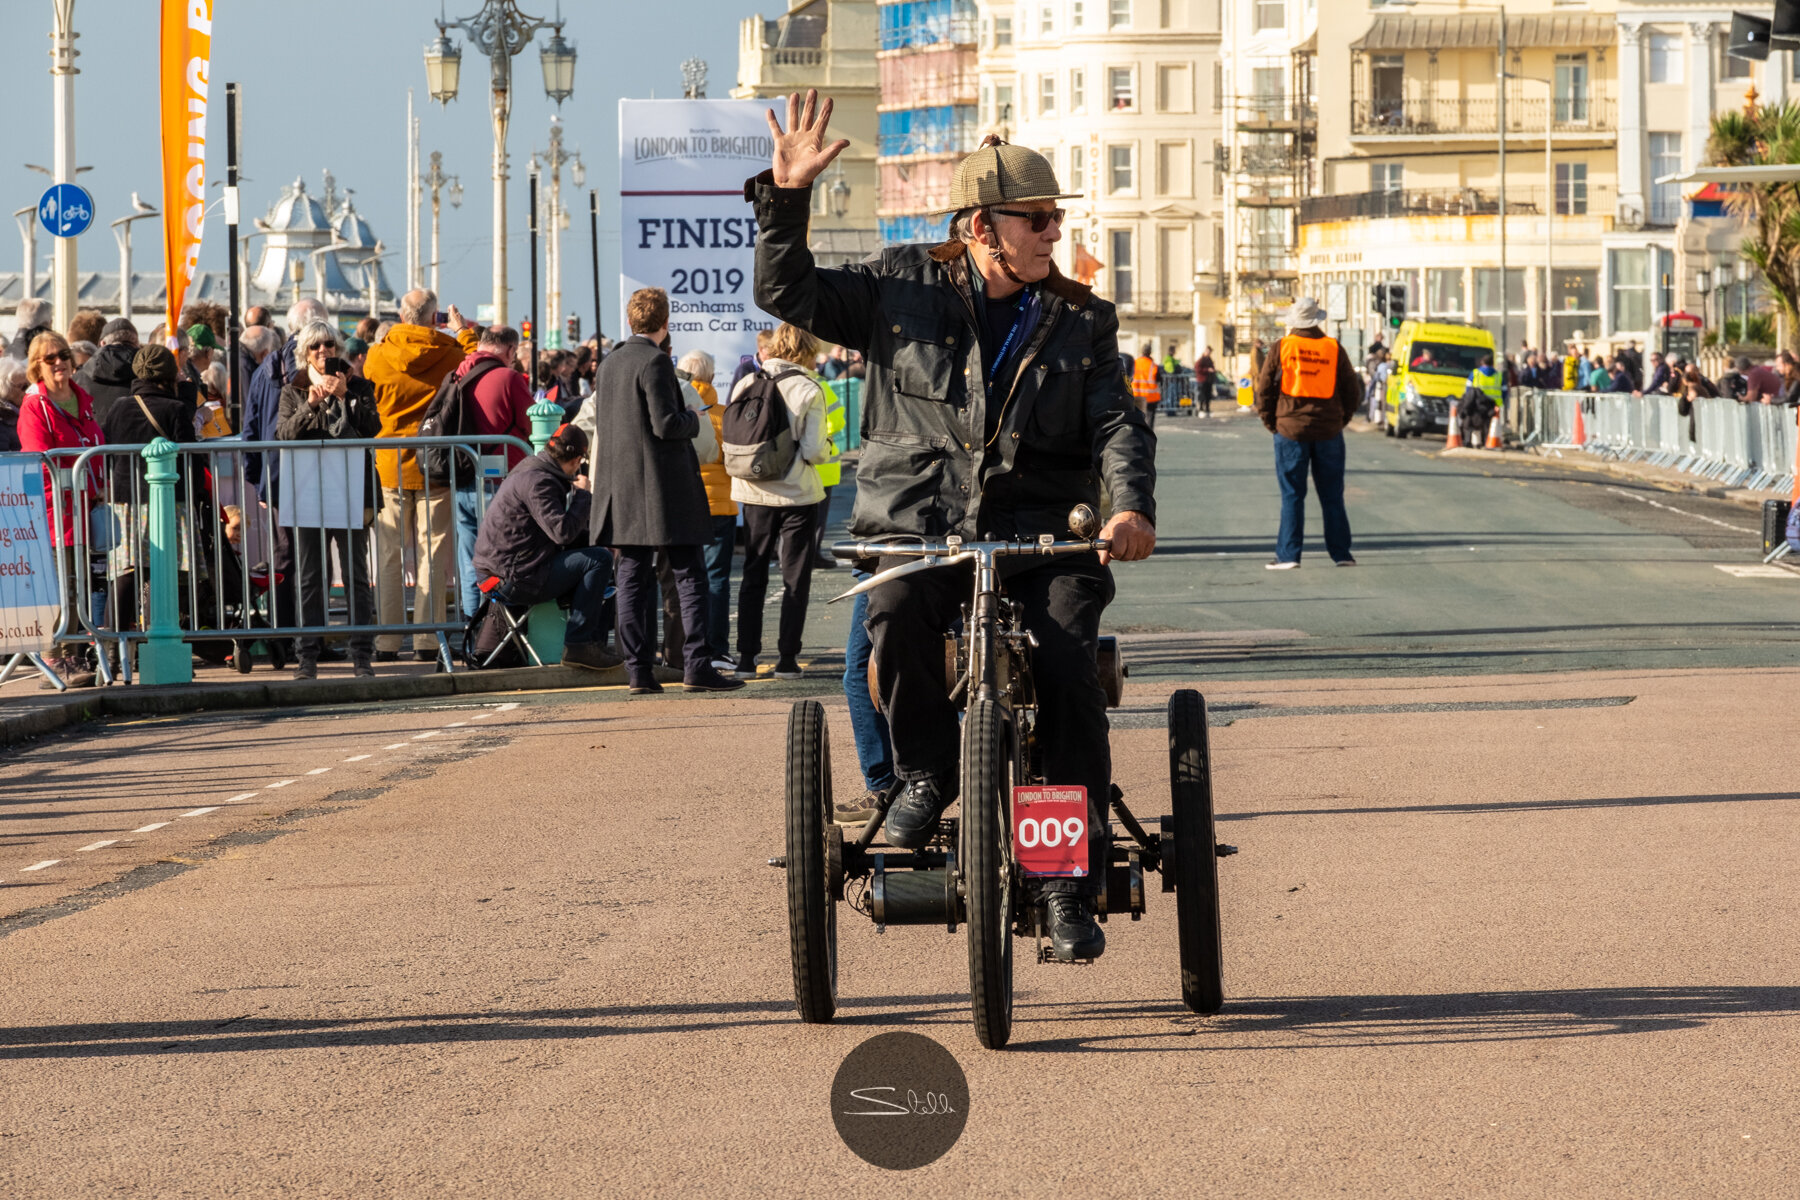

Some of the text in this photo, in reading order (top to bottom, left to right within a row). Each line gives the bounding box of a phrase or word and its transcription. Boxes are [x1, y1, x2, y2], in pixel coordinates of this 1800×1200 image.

[634, 136, 775, 160] LONDON TO BRIGHTON
[671, 268, 744, 294] 2019
[671, 301, 745, 313] Bonhams
[708, 319, 738, 331] Car
[743, 319, 773, 331] Run
[0, 486, 34, 510] tion,
[13, 520, 38, 540] and
[0, 555, 35, 576] eeds.
[1018, 790, 1082, 803] LONDON TO BRIGHTON
[1018, 817, 1084, 848] 009
